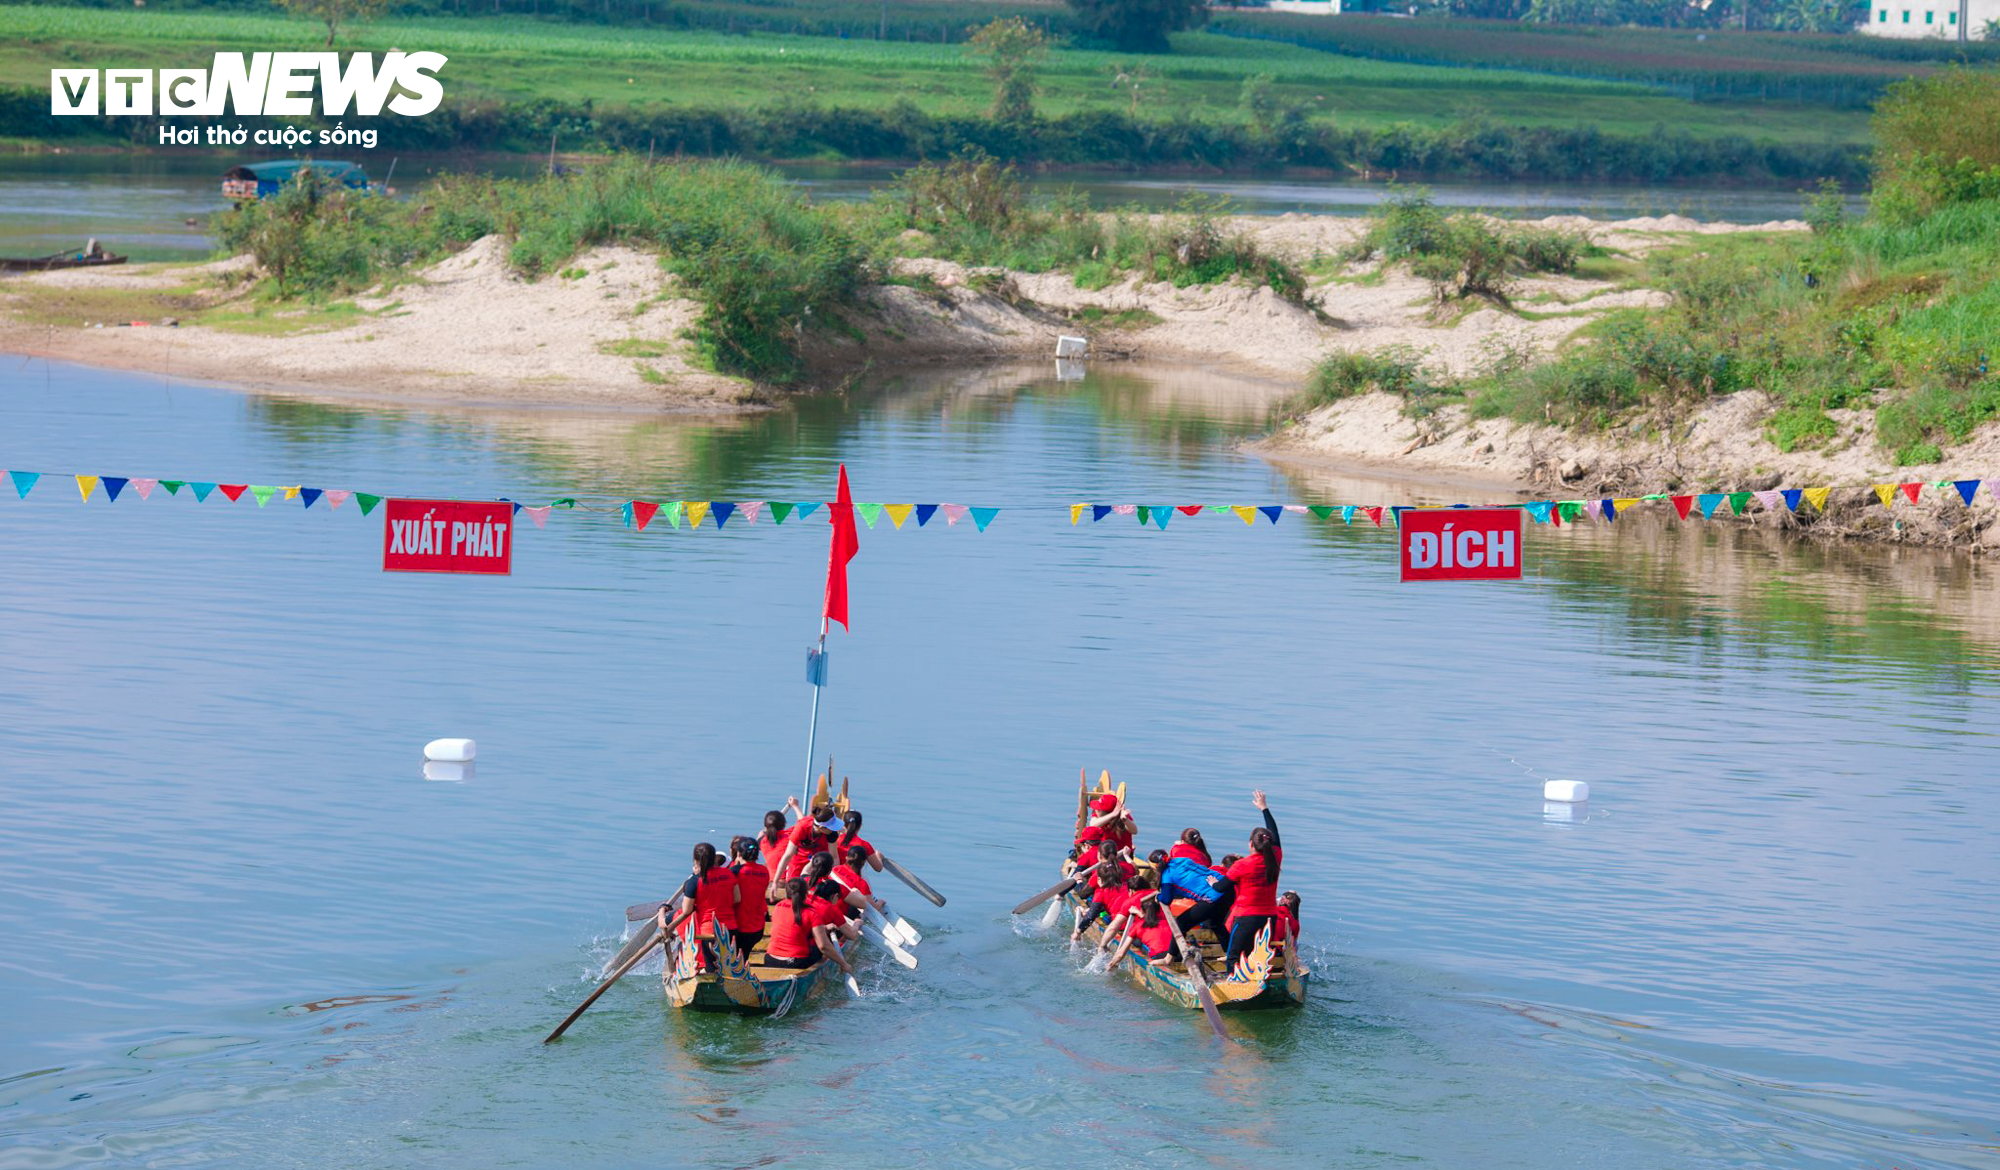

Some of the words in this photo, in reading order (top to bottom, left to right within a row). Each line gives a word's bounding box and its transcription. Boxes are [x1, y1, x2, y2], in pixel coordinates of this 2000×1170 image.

[389, 508, 446, 555] XUẤT
[451, 515, 507, 558] PHÁT
[1408, 522, 1515, 569] ĐÍCH
